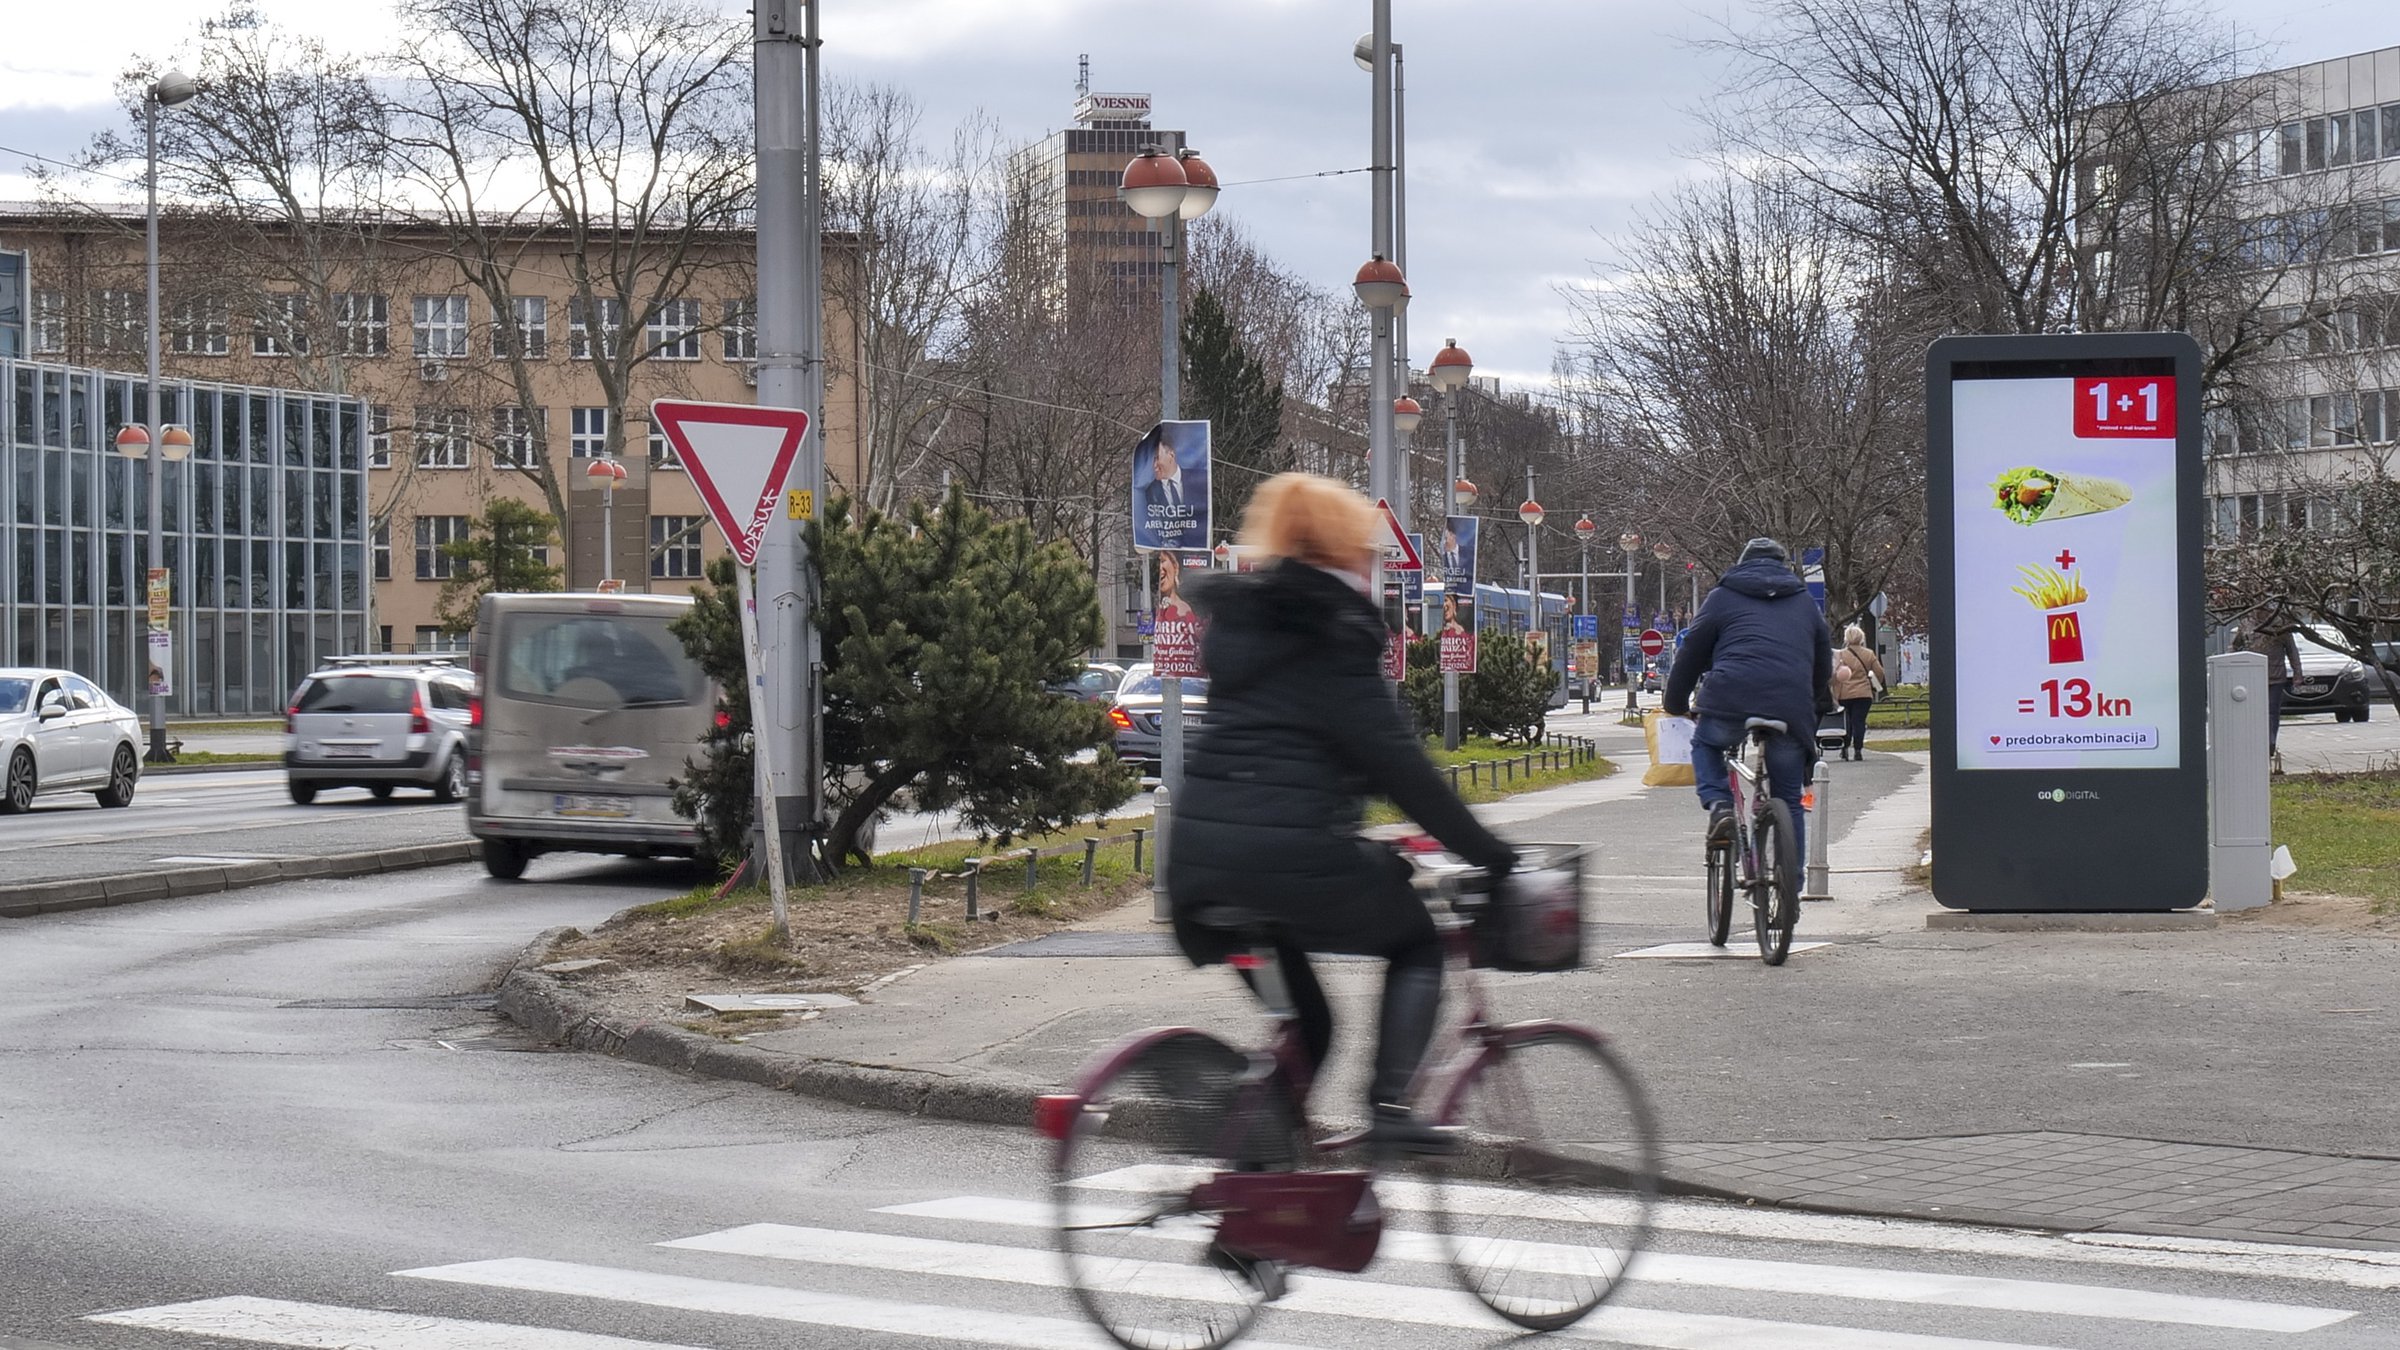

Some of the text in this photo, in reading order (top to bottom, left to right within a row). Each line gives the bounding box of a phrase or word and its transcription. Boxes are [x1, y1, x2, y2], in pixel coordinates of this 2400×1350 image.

[1093, 97, 1149, 109] VJESNIK
[2089, 382, 2158, 422] 1+1
[790, 495, 811, 514] R-33
[1163, 519, 1198, 530] ZAGREB
[2097, 692, 2131, 717] kn
[2005, 732, 2147, 747] predobrakombinacija
